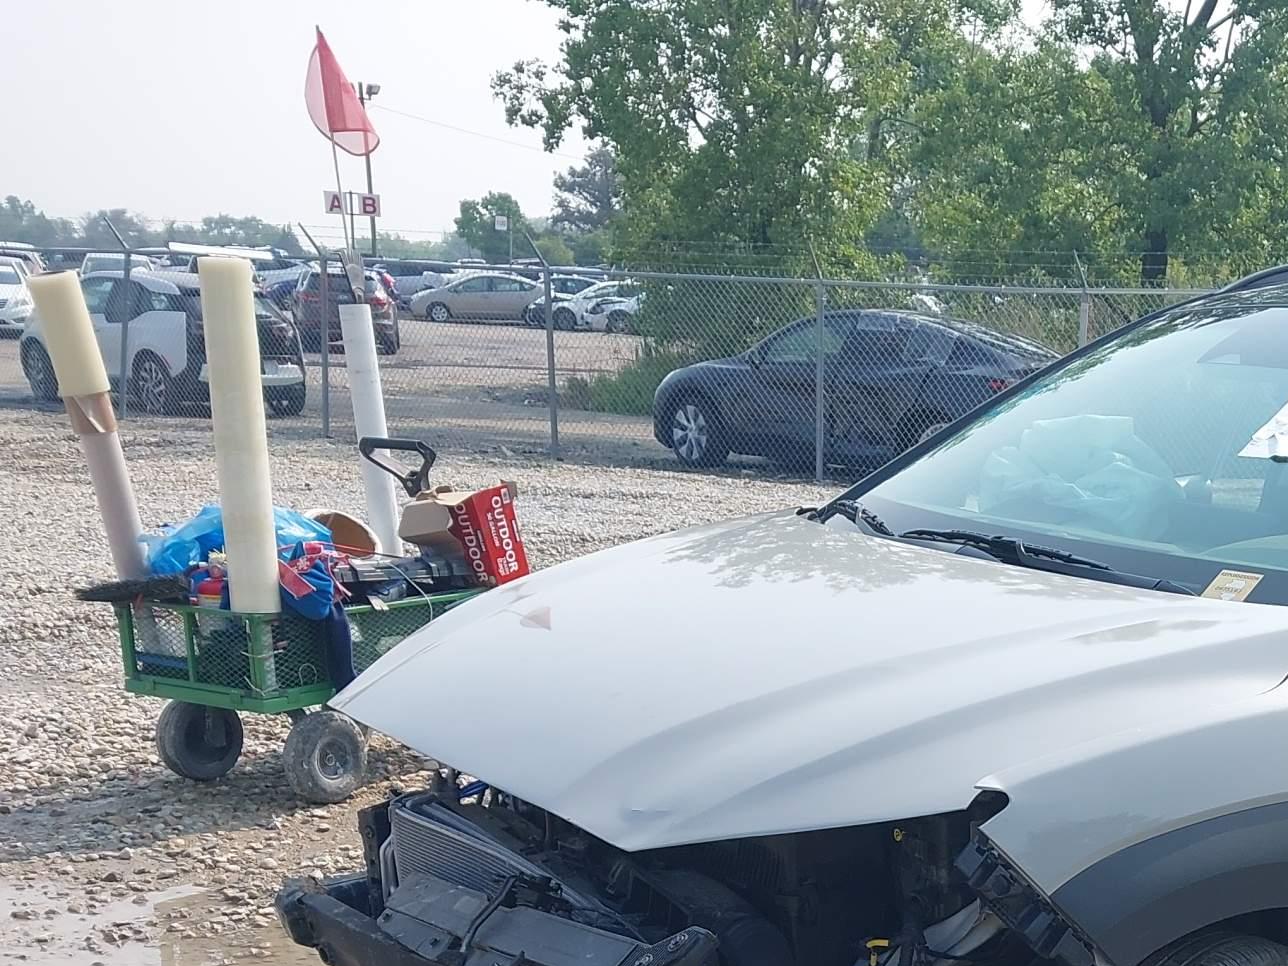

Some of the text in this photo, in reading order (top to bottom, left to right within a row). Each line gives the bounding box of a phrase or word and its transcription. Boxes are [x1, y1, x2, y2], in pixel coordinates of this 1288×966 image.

[329, 194, 343, 212] A
[362, 196, 377, 215] B
[454, 503, 489, 582] OUTDOOR
[488, 520, 501, 548] GALLON
[491, 495, 519, 573] OUTDOOR
